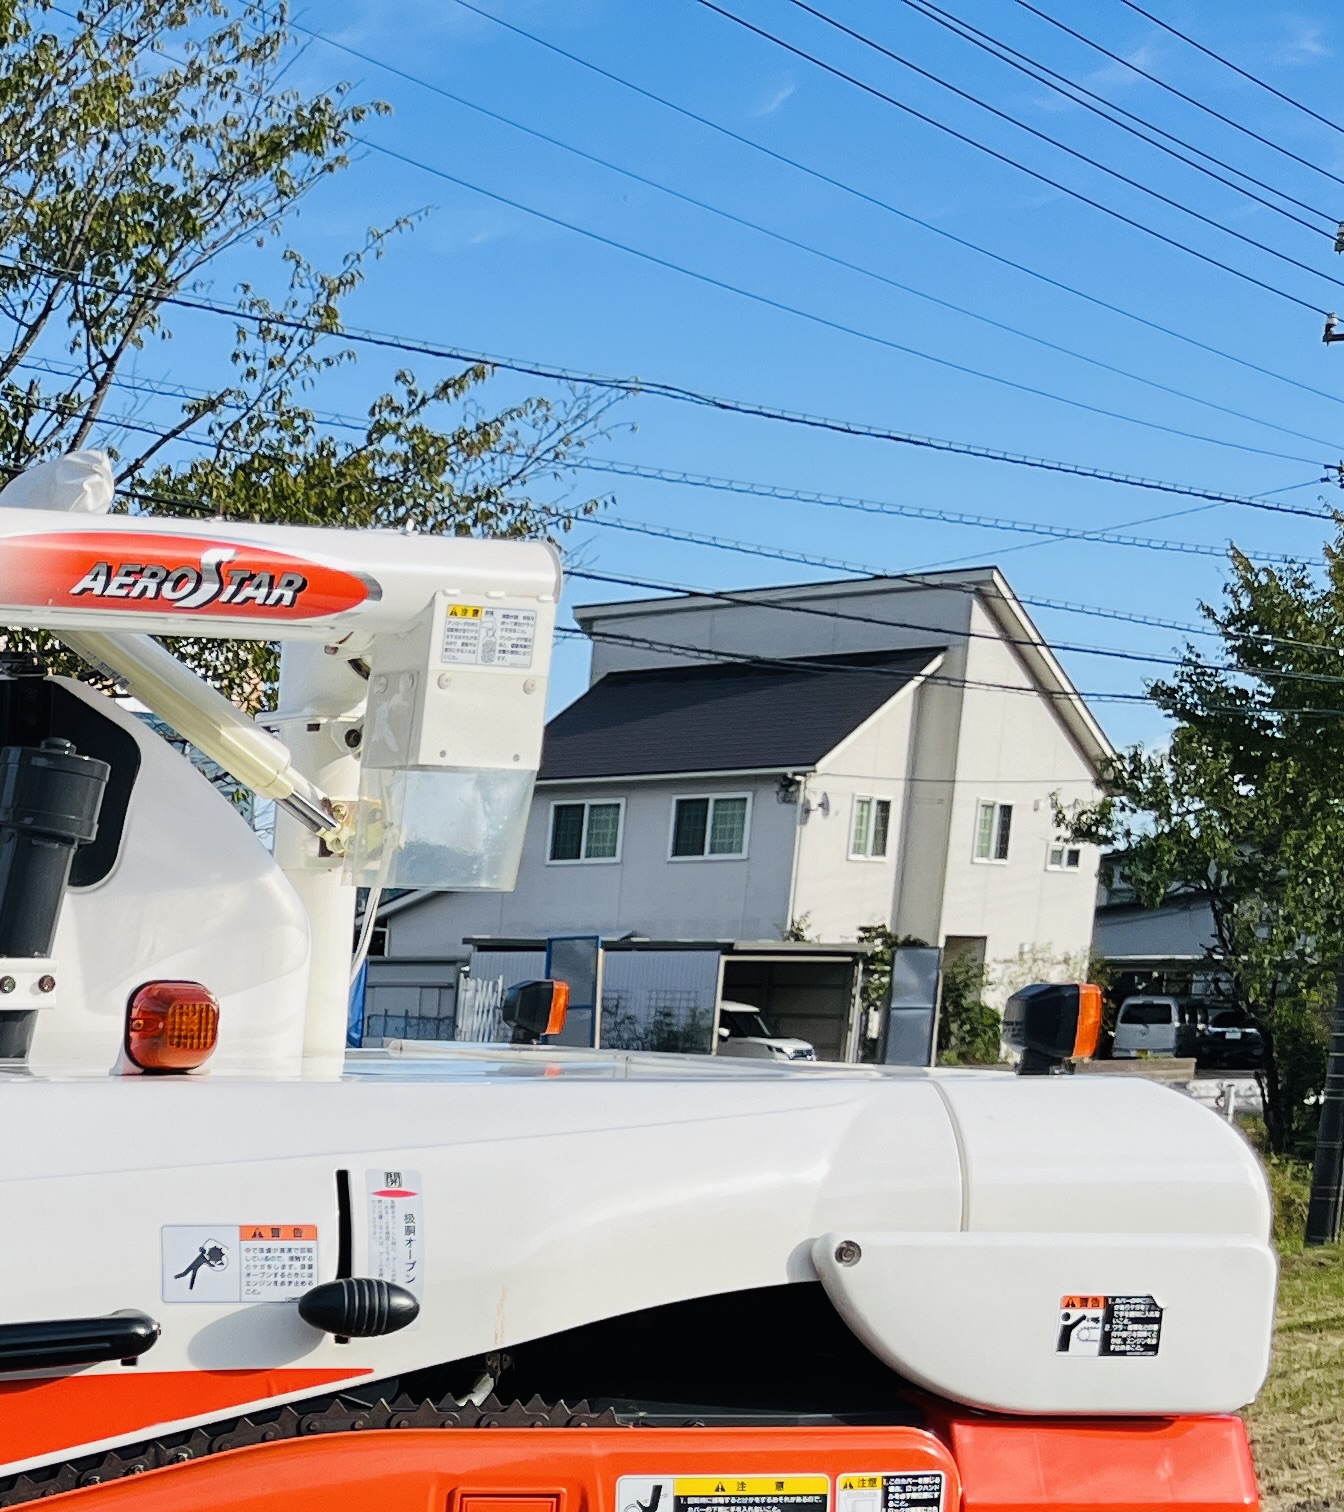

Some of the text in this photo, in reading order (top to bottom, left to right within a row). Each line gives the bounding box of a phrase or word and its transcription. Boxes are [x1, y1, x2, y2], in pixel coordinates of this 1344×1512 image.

[69, 548, 308, 608] AEROSTAR
[385, 1172, 402, 1188] 開
[857, 1477, 878, 1488] 注意
